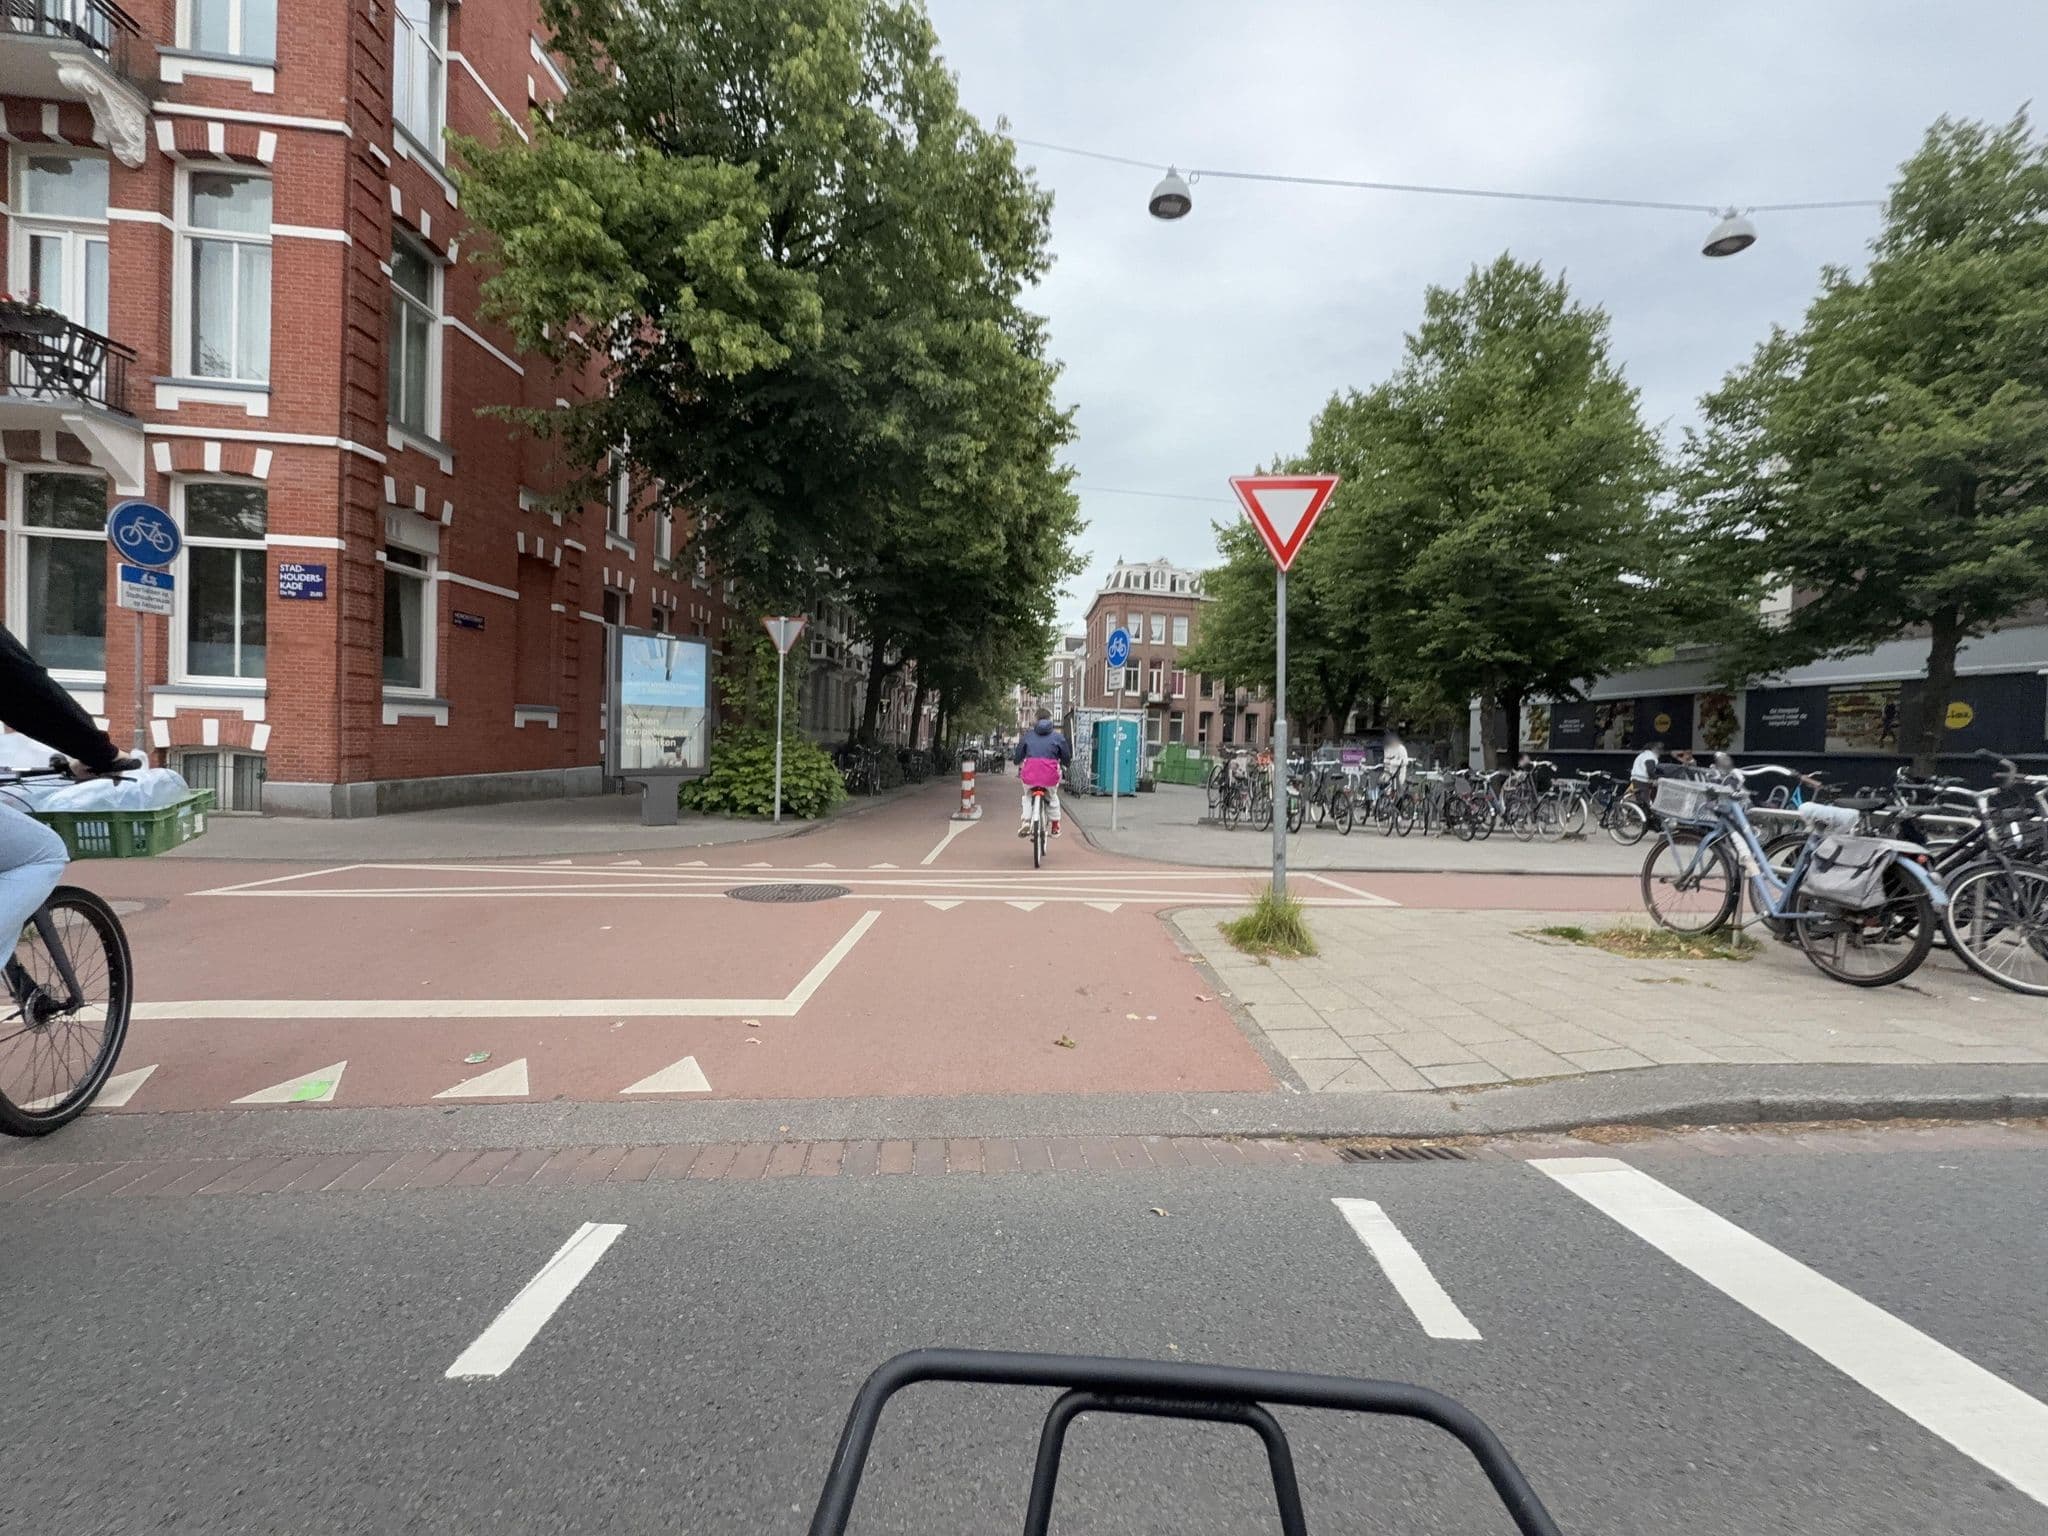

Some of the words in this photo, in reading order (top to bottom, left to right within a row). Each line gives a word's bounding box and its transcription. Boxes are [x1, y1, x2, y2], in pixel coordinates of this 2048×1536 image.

[280, 564, 305, 572] STAD-
[280, 573, 323, 583] HOUDERS-
[280, 582, 303, 591] KADE
